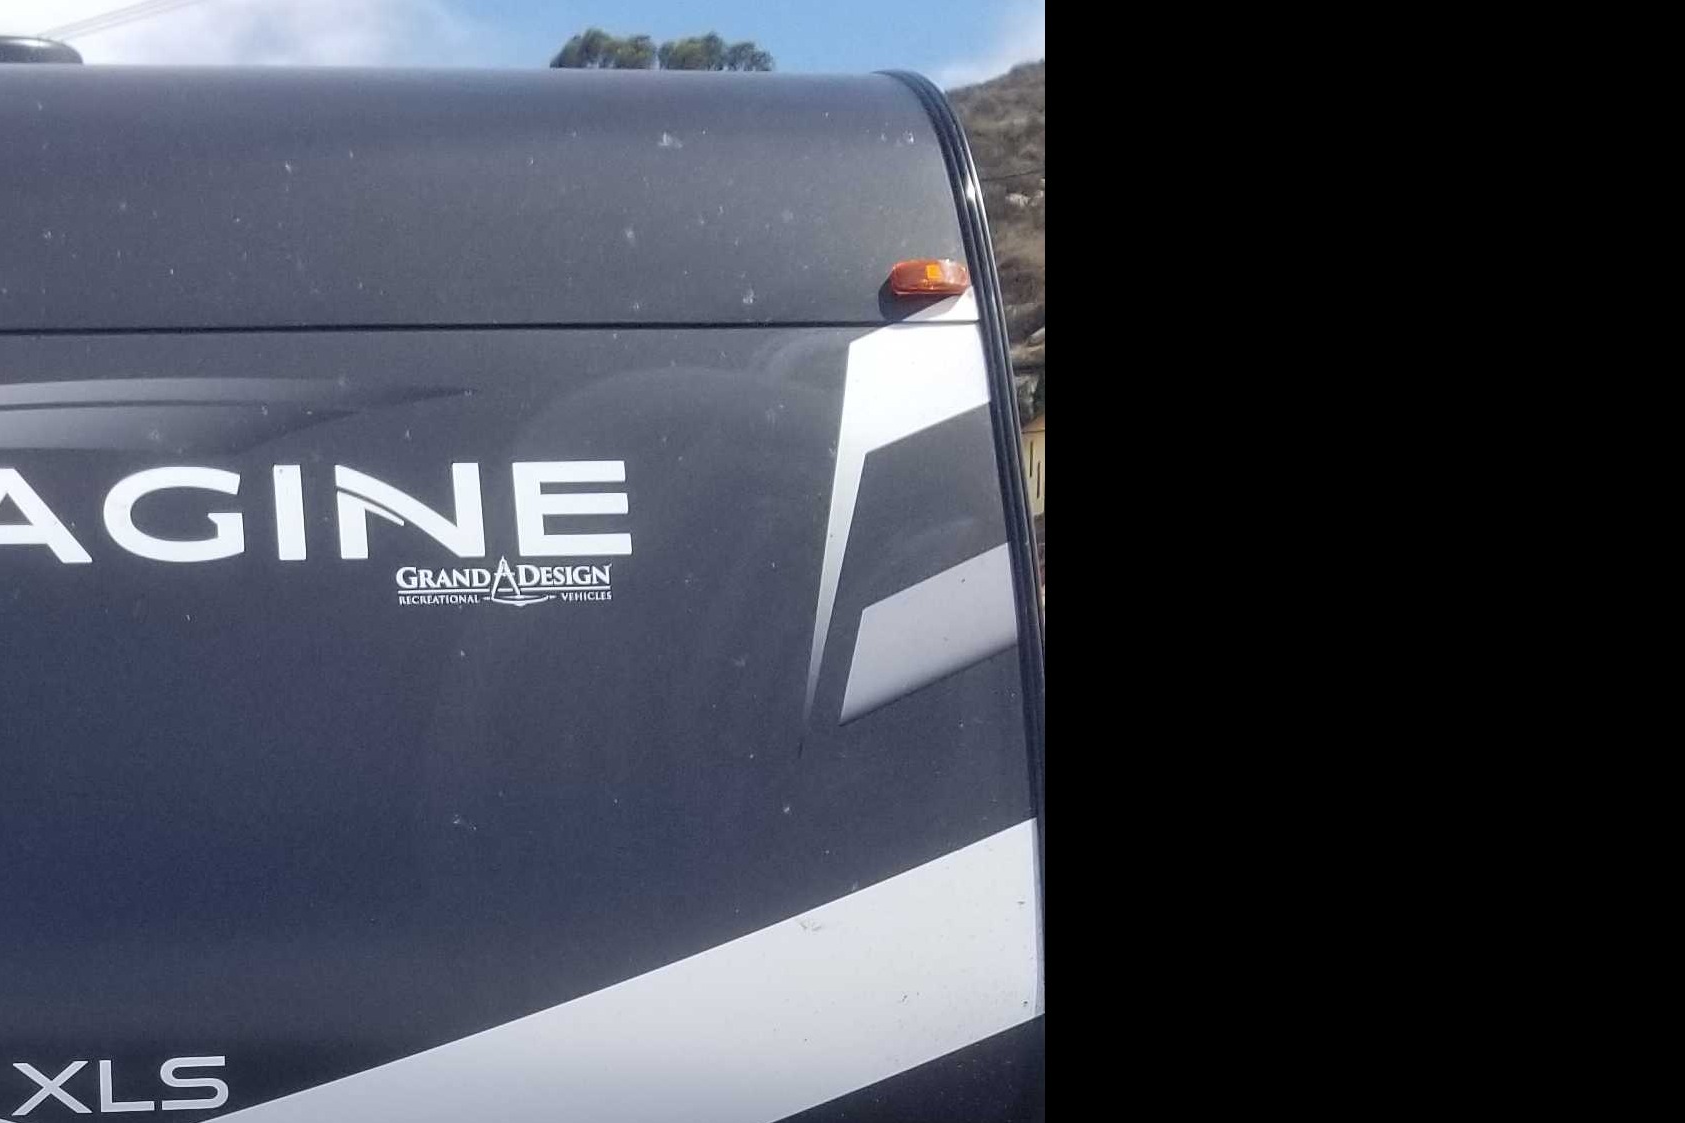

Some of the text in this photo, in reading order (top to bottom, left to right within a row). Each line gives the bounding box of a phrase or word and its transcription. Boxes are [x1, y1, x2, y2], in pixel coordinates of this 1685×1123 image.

[396, 564, 612, 589] GRAND DESIGN
[398, 594, 480, 606] RECREATIONAL
[561, 591, 612, 602] VEHICLES
[11, 1055, 229, 1116] XLS
